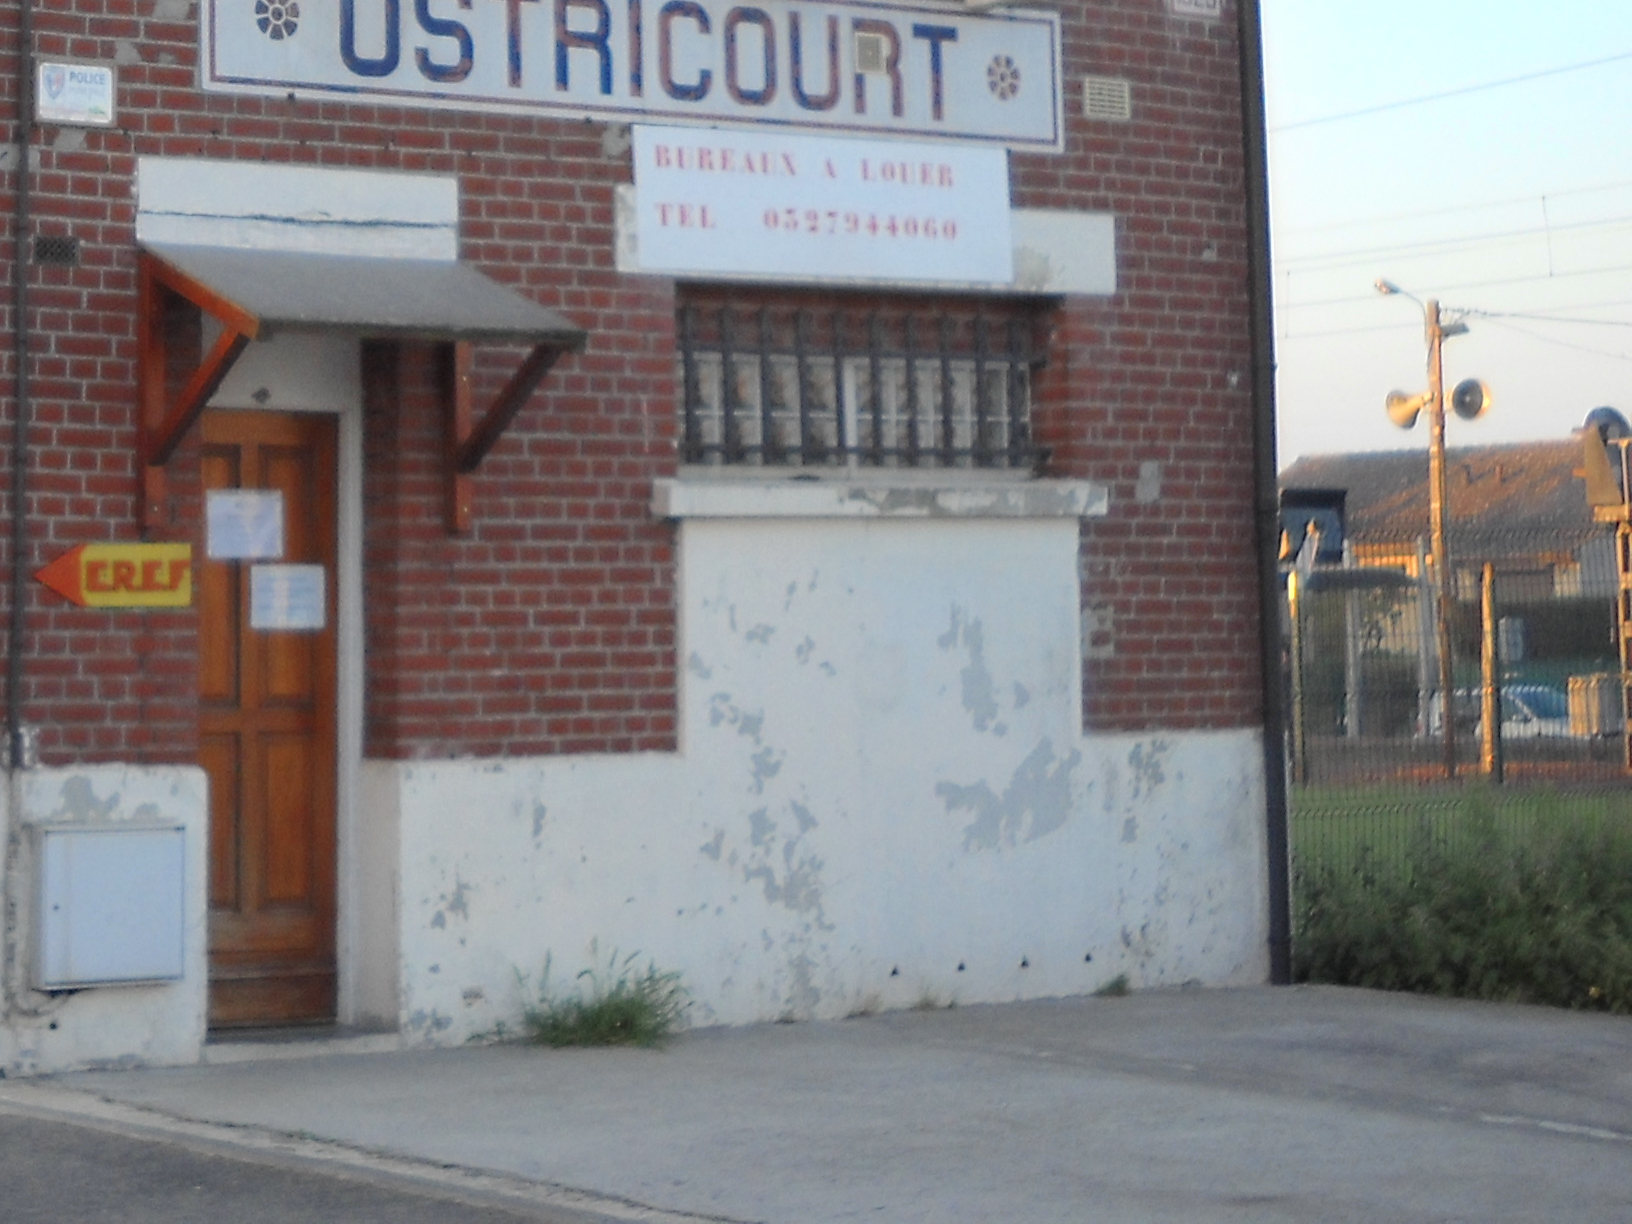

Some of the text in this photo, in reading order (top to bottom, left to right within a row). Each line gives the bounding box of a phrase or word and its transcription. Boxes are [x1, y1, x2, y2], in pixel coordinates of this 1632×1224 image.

[69, 70, 106, 86] POLICE
[654, 144, 955, 187] BUREAUX A LOUER
[654, 202, 716, 230] TEL
